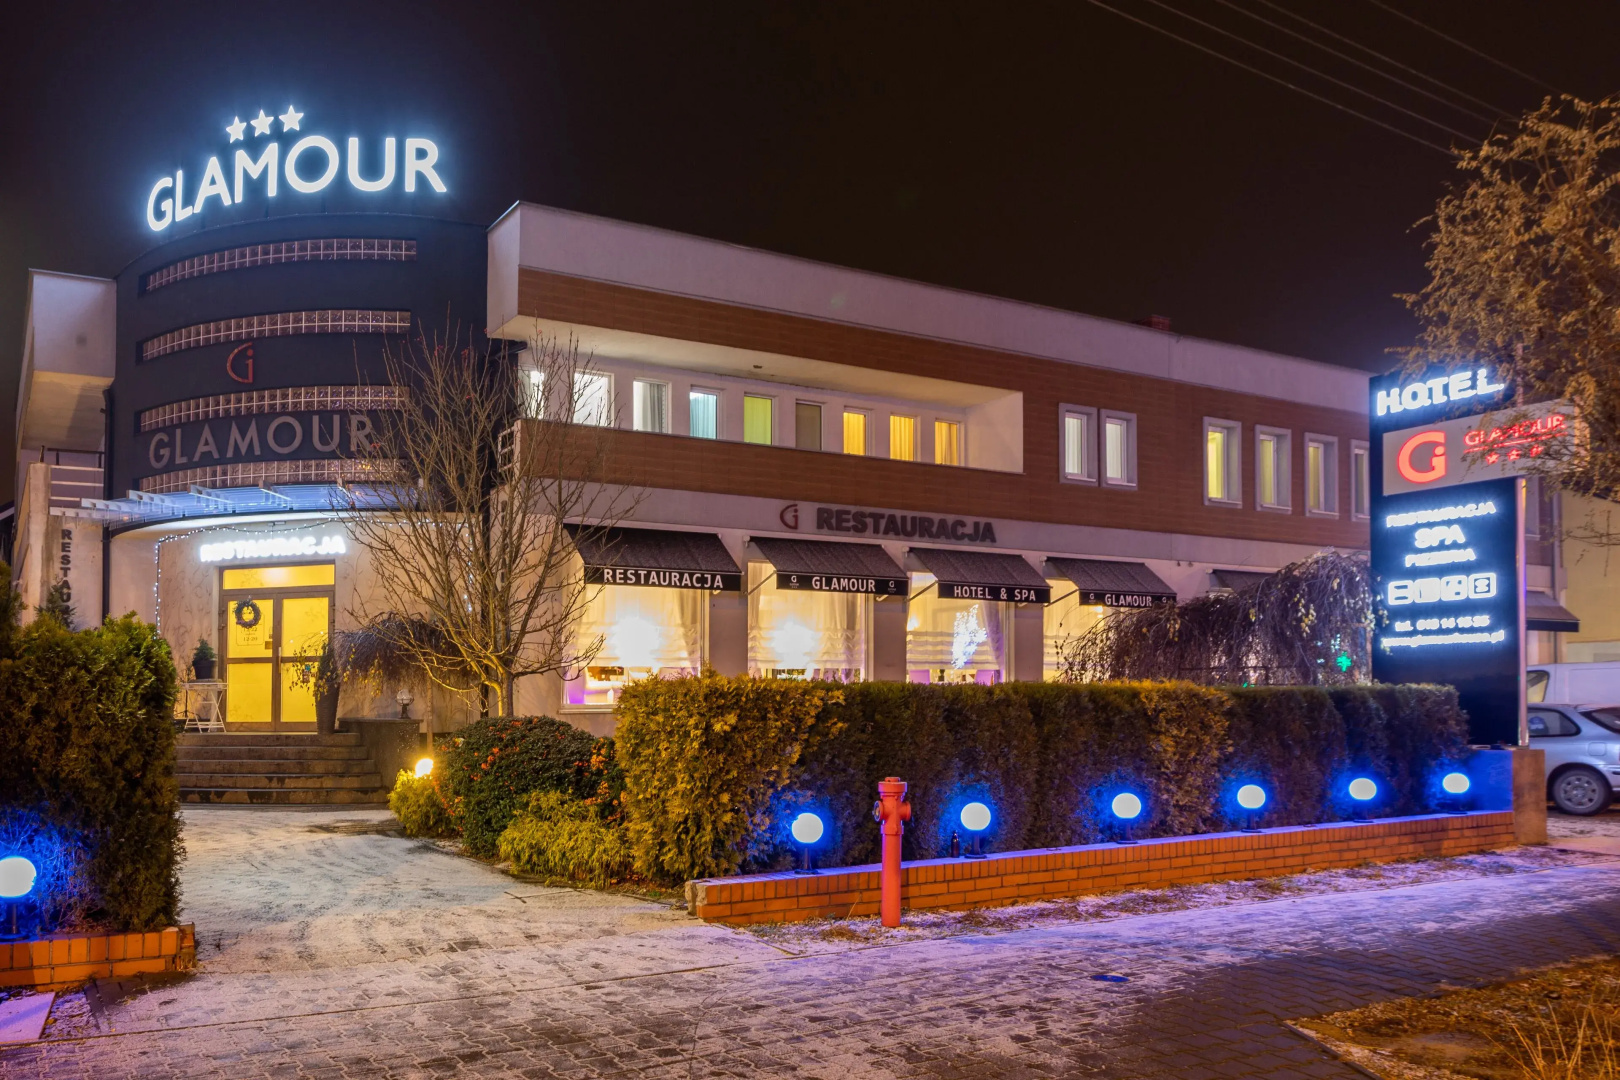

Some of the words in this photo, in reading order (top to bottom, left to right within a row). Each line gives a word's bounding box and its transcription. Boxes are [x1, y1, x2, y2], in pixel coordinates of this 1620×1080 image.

[147, 135, 447, 231] GLAMOUR
[1377, 369, 1504, 416] HOTEL
[149, 415, 373, 469] GLAMOUR
[816, 507, 997, 543] RESTAURACJA
[1415, 524, 1465, 548] SPA
[603, 568, 724, 589] RESTAURACJA
[811, 576, 876, 592] GLAMOUR
[1000, 588, 1007, 599] &
[1014, 589, 1036, 601] SPA
[1105, 593, 1152, 606] GLAMOUR
